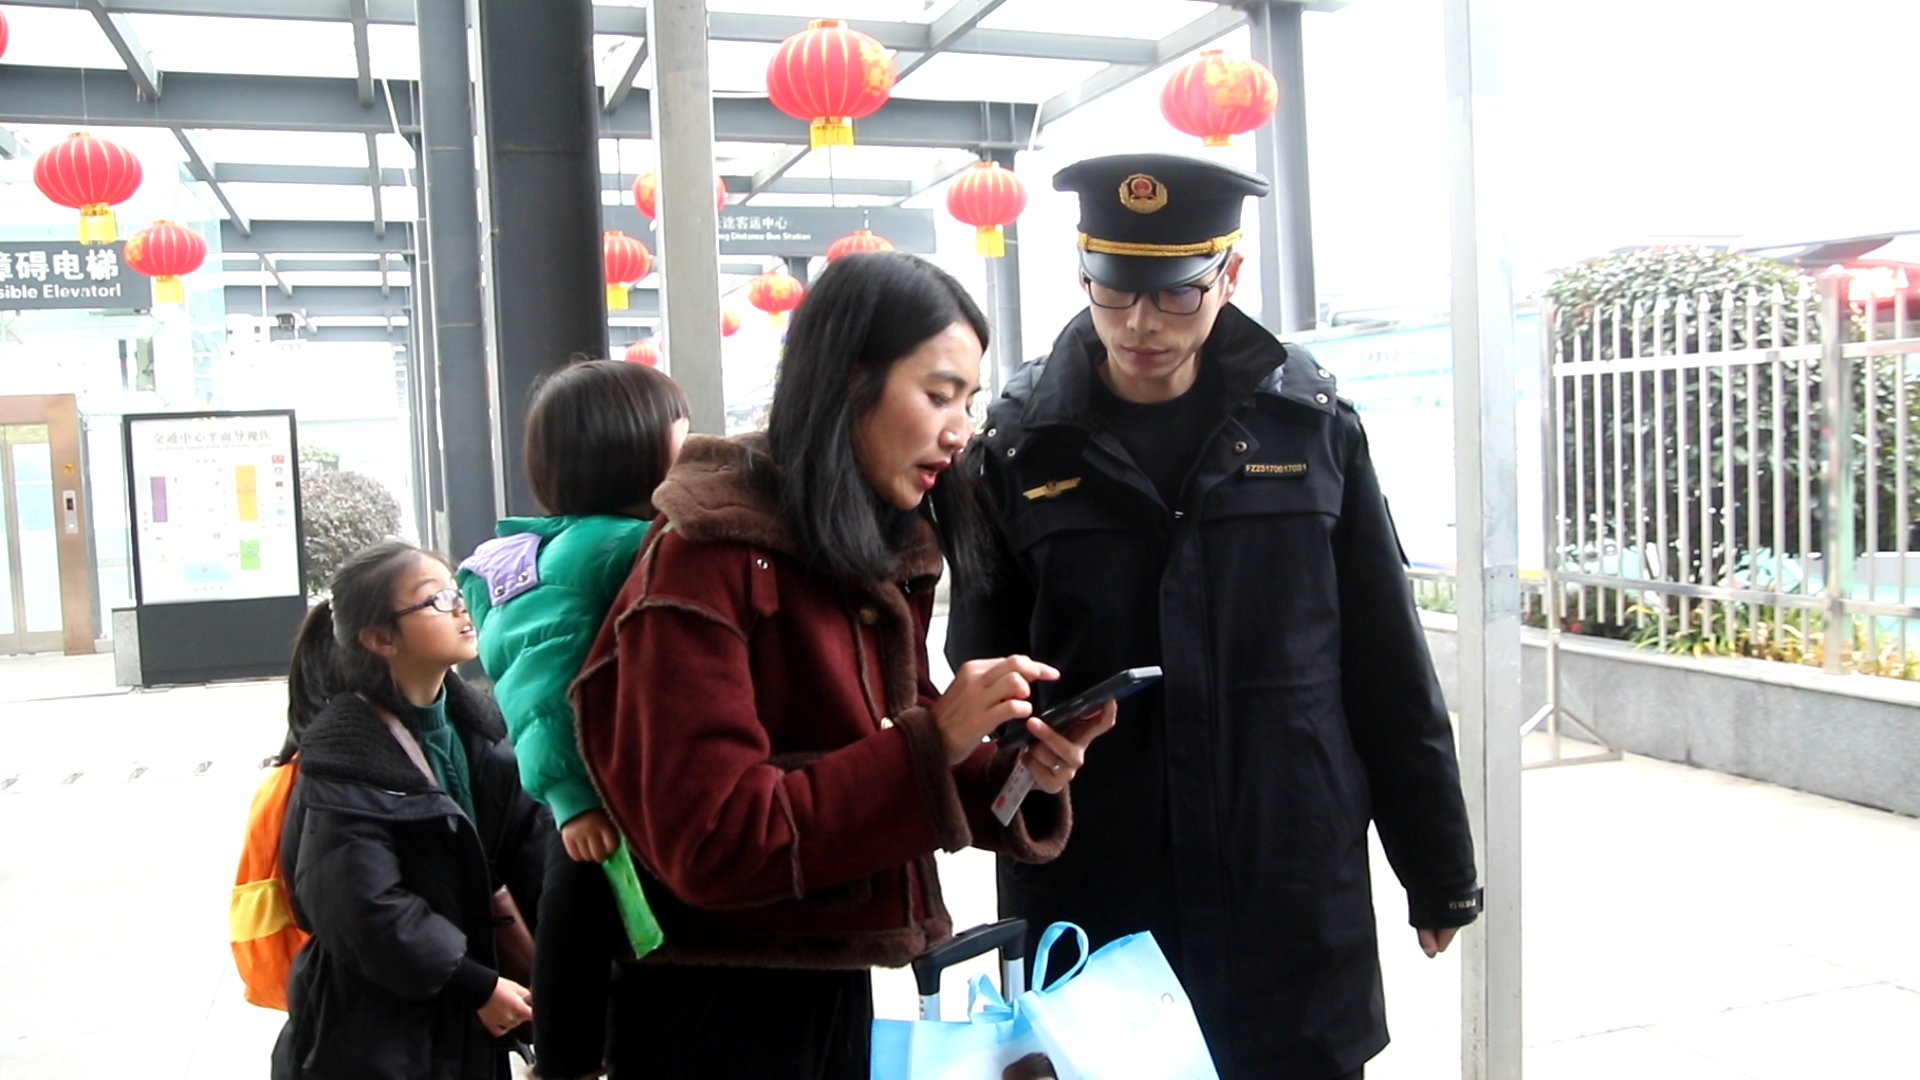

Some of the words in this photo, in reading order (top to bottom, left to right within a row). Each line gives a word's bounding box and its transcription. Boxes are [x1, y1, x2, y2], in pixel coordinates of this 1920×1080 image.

[731, 232, 765, 241] Distance
[766, 232, 781, 241] Bus
[782, 232, 812, 241] Station
